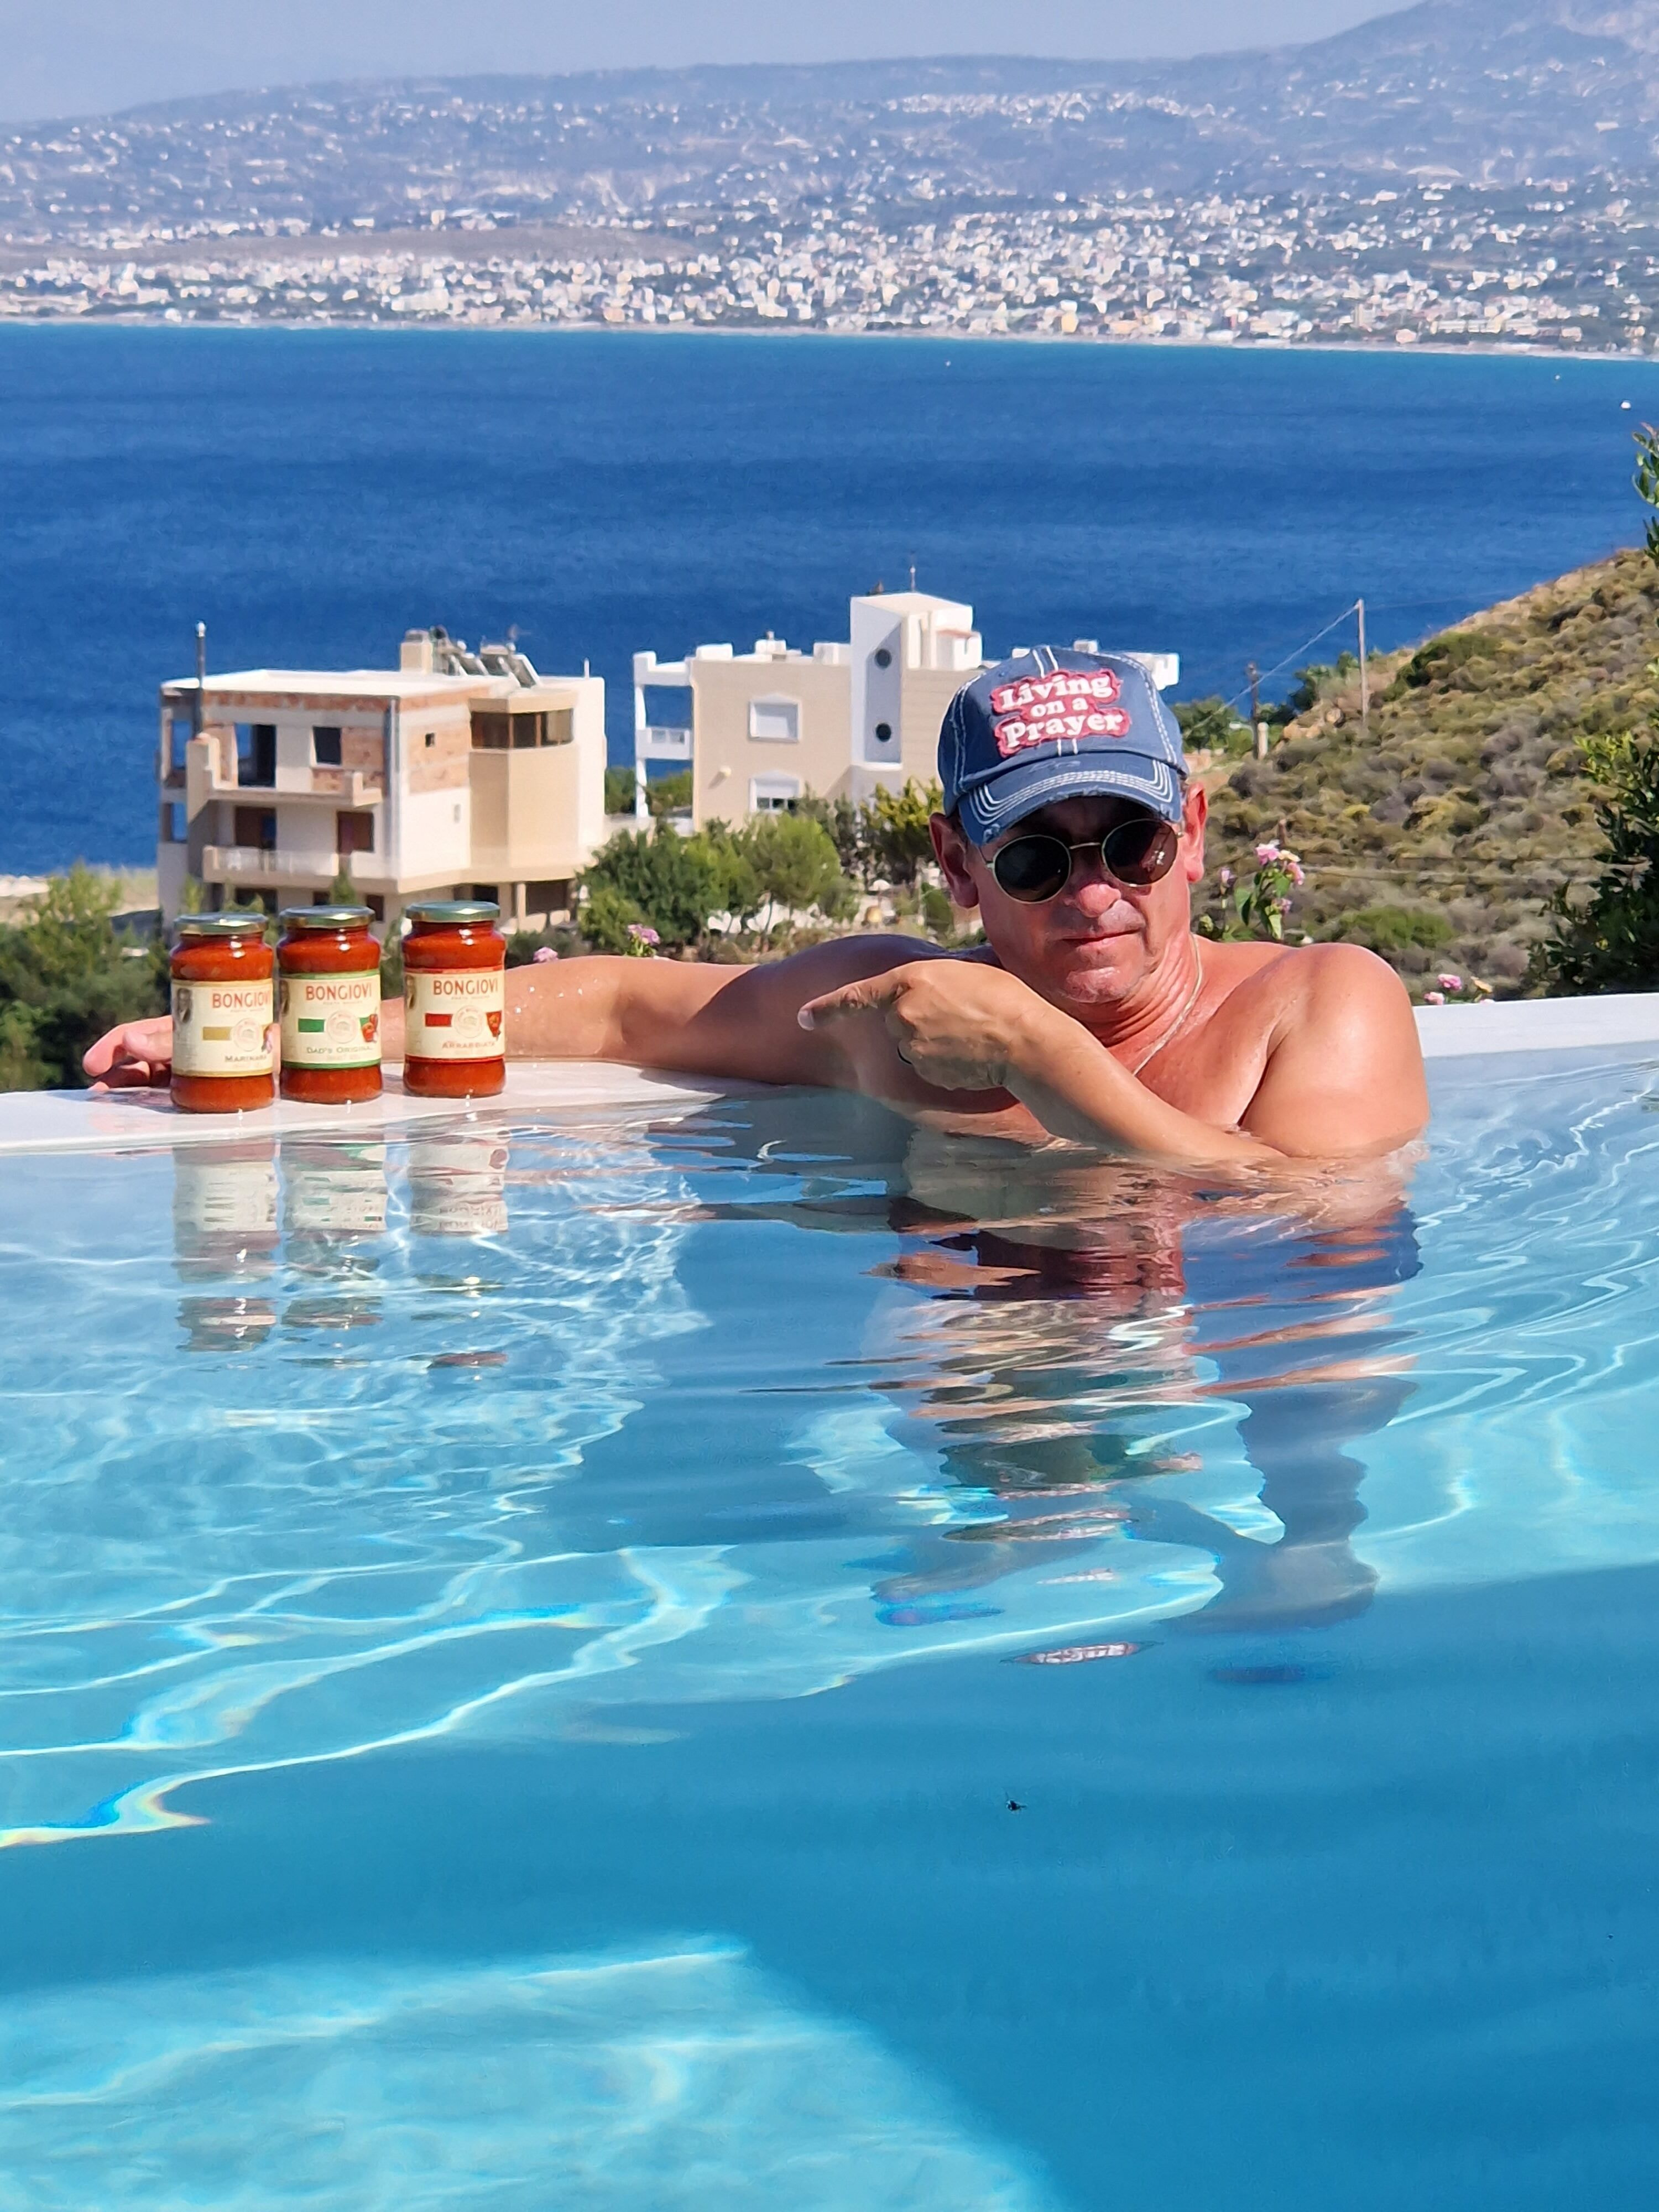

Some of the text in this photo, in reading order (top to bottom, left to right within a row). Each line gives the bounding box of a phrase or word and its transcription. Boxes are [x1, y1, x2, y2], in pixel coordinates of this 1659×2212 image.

[999, 674, 1113, 709] Living
[1030, 697, 1088, 717] on a
[1001, 713, 1123, 748] Prayer
[306, 983, 372, 1001] BONGIOVI
[433, 978, 498, 995] BONGIOVI
